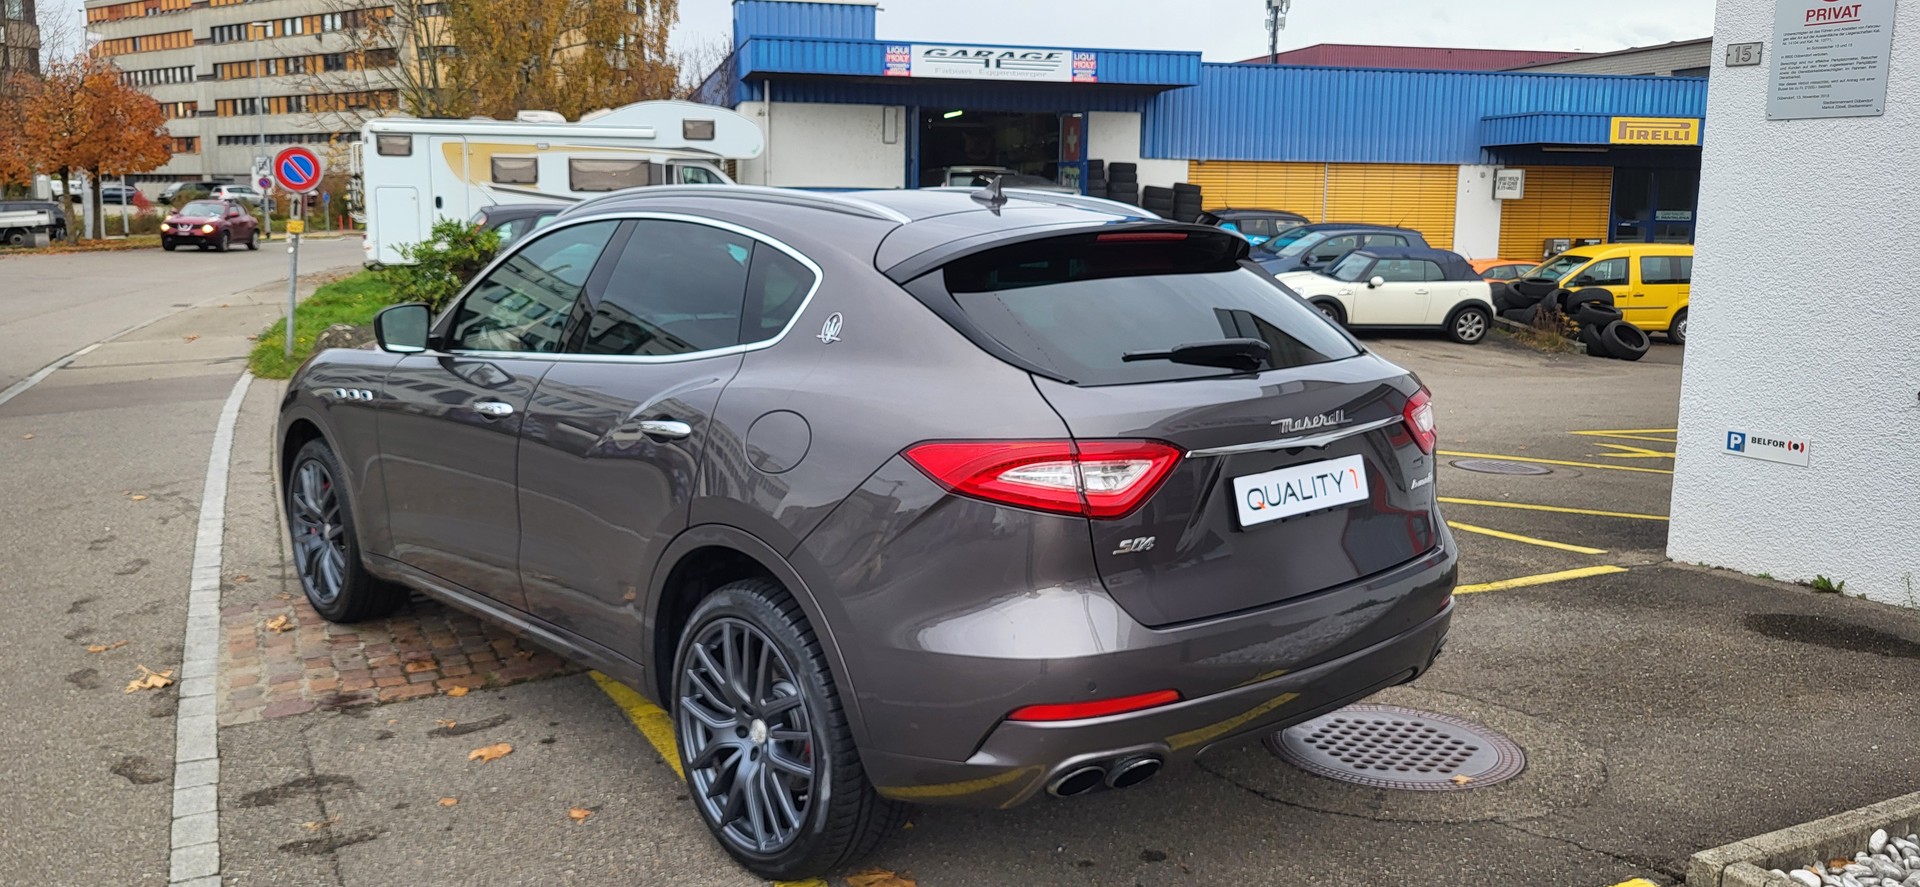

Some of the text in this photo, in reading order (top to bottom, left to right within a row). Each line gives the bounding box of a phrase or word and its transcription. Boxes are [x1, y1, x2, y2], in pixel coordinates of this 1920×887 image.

[1805, 4, 1862, 22] PRIVAT
[923, 48, 1063, 61] GARAGE
[1735, 46, 1752, 63] 15
[1618, 120, 1691, 141] PIRELLI
[1271, 409, 1353, 433] Maserati
[1730, 433, 1785, 449] P BELFOR
[1246, 468, 1359, 511] QUALITY 1
